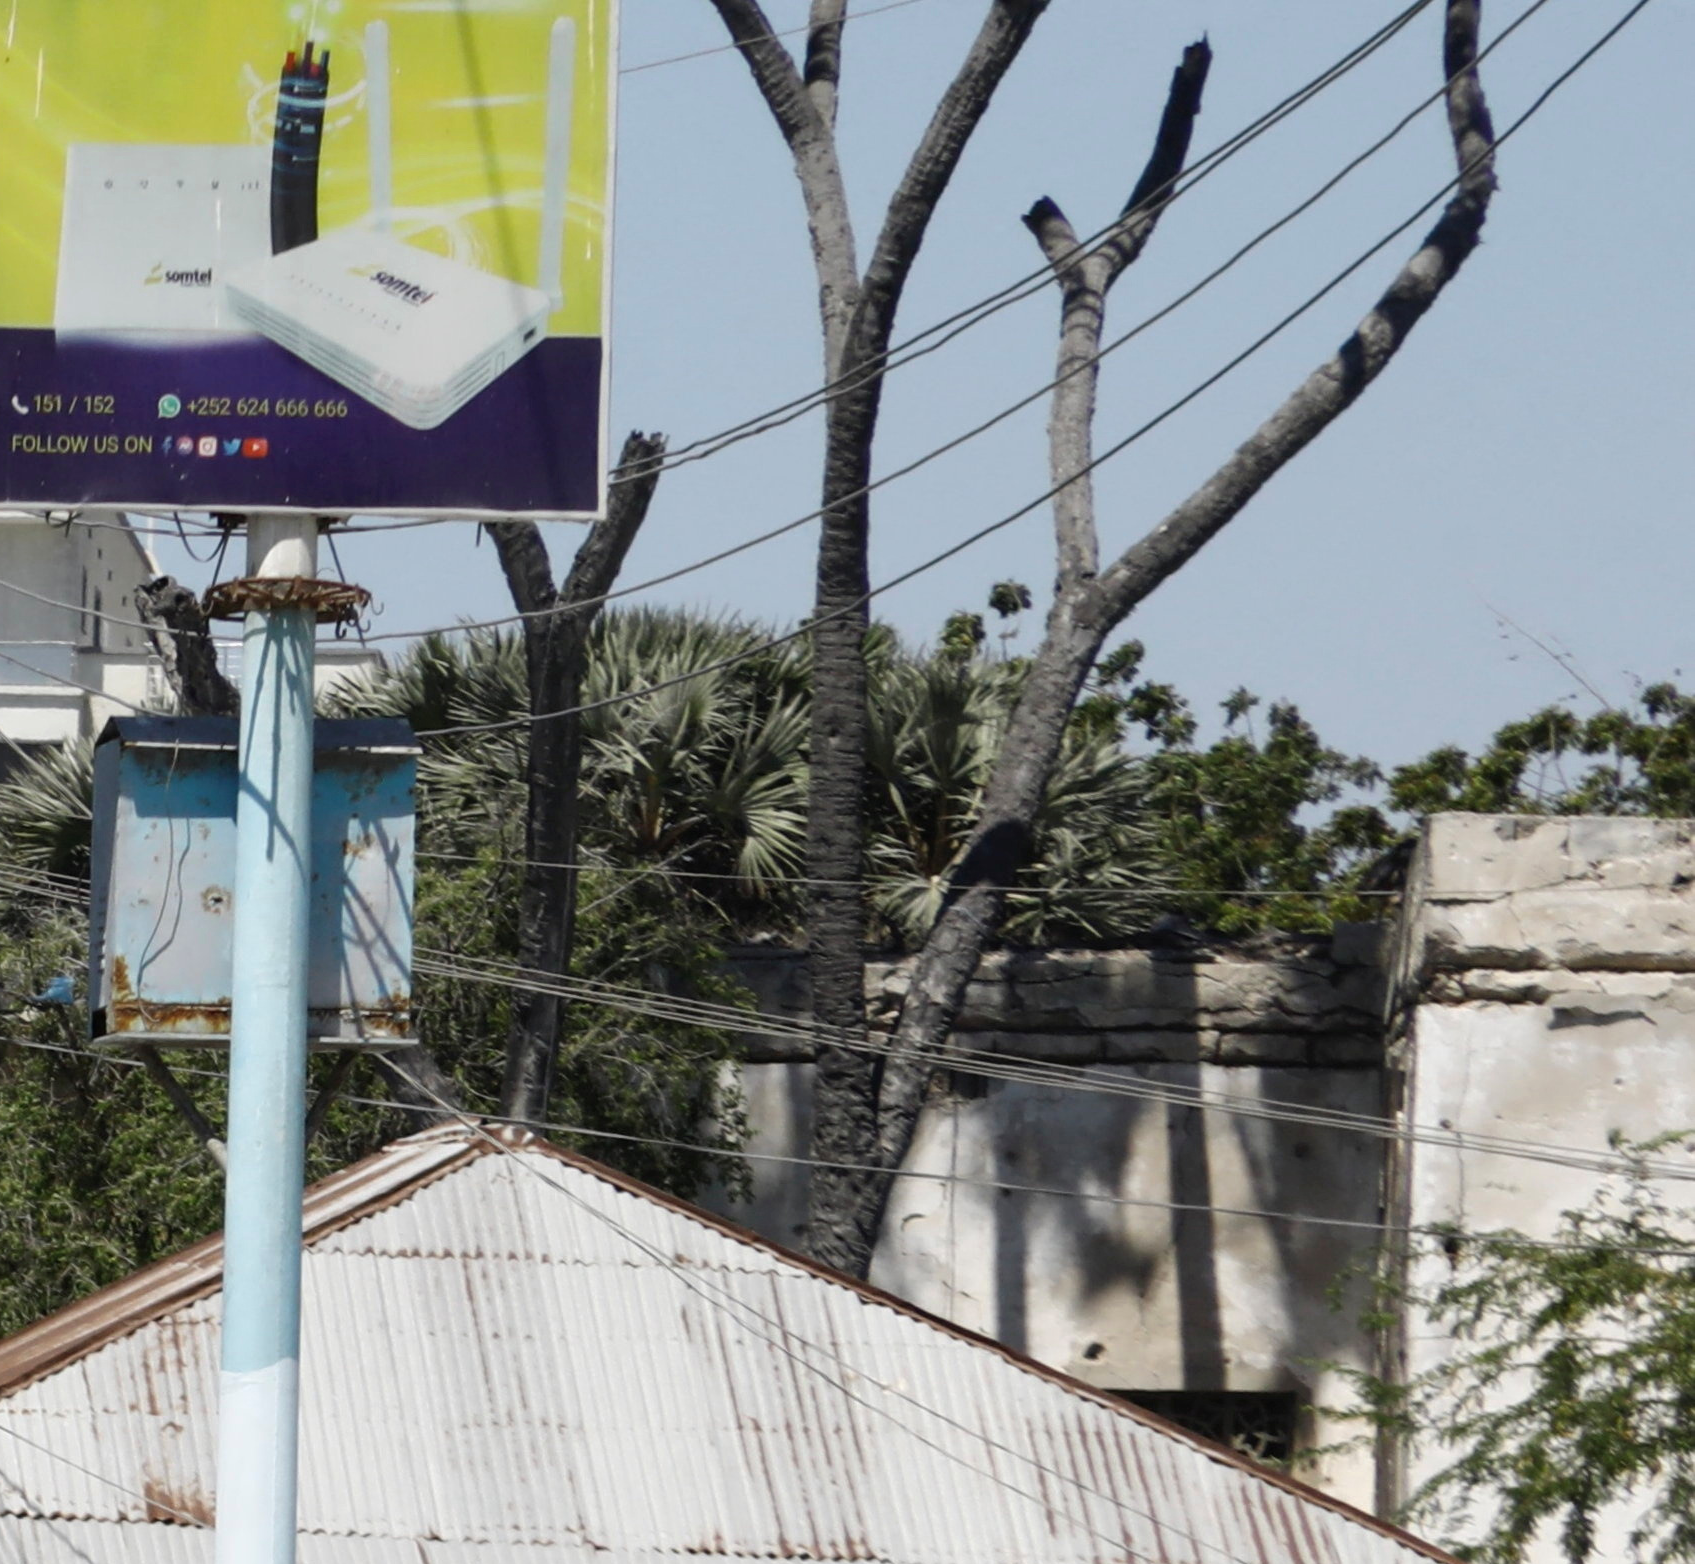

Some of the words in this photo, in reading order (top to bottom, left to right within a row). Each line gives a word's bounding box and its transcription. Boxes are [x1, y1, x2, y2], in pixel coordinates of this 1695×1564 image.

[165, 268, 212, 283] somtel
[370, 270, 437, 304] somtel
[33, 395, 62, 413] 151
[69, 396, 77, 414] /
[84, 396, 114, 413] 152
[187, 398, 230, 416] +252
[237, 398, 269, 416] 624
[275, 400, 308, 416] 666
[314, 400, 347, 417] 666
[12, 435, 88, 453] FOLLOW
[94, 435, 119, 453] US
[124, 436, 152, 454] ON
